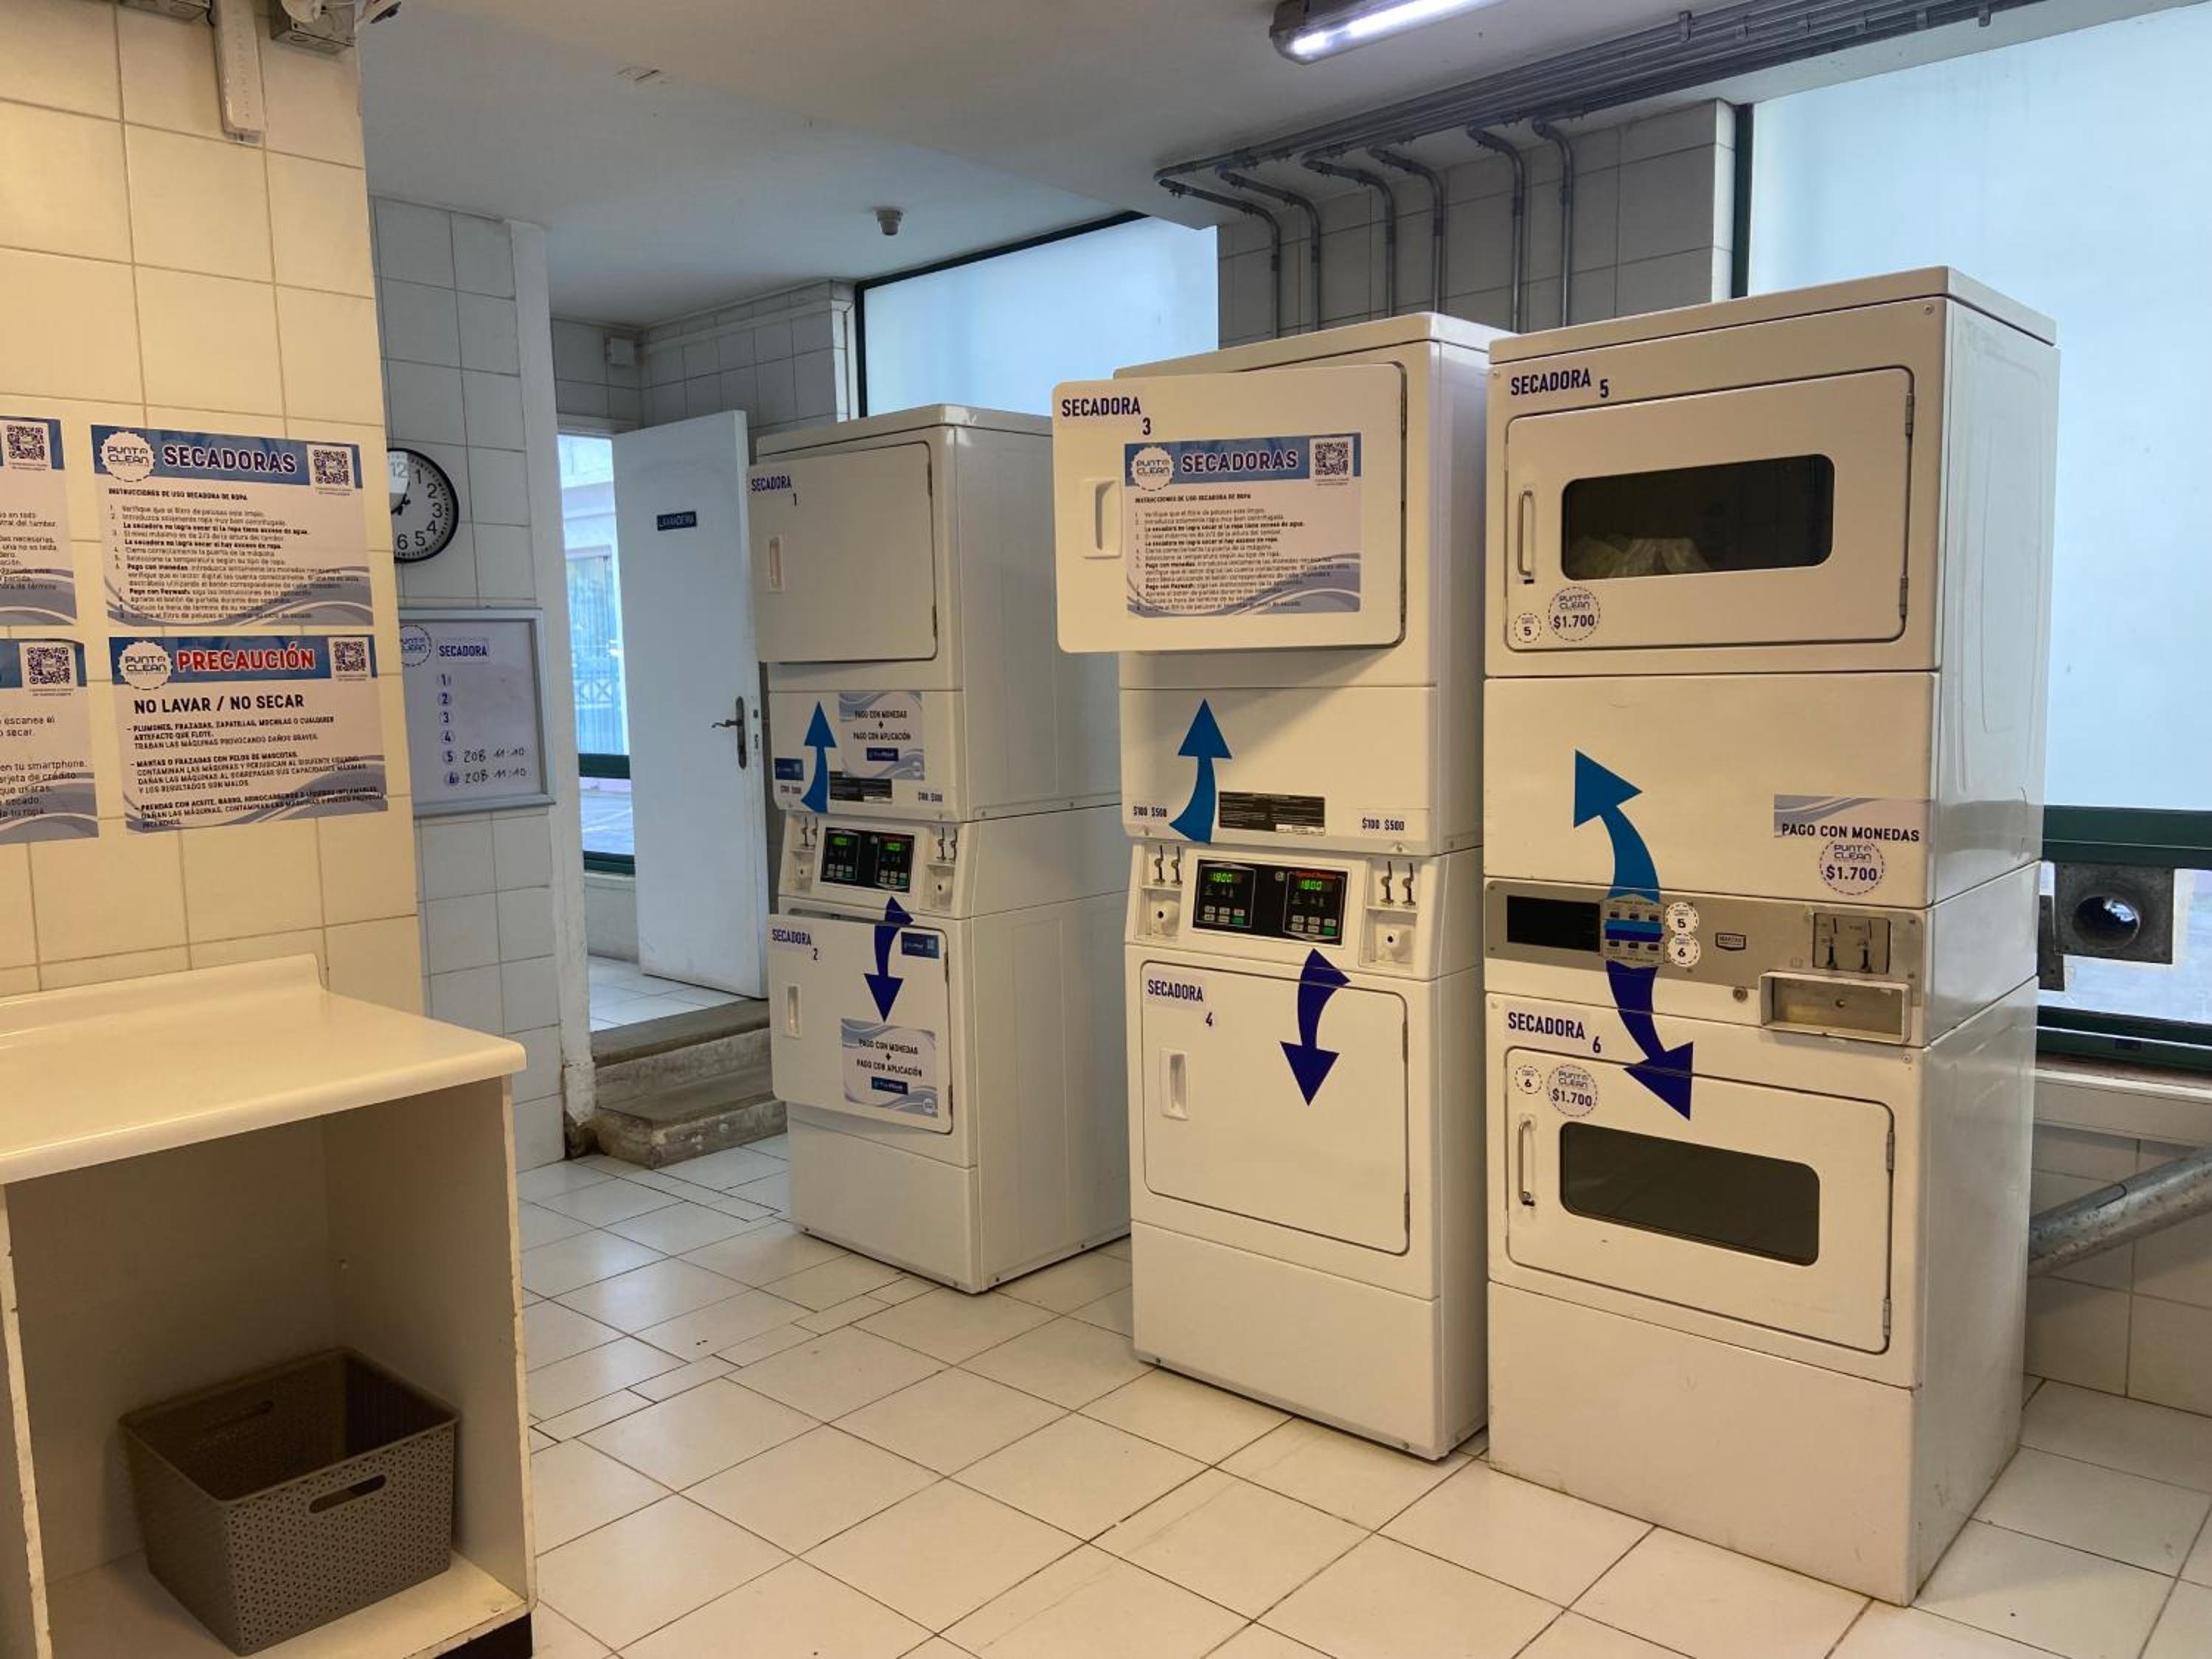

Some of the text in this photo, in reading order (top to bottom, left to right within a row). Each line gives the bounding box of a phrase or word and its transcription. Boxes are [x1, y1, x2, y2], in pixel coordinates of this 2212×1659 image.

[1511, 368, 1610, 398] SECADORA 5
[1061, 397, 1141, 417] SECADORA
[1142, 417, 1152, 435] 3
[164, 446, 295, 473] SECADORAS
[1183, 451, 1298, 473] SECADORAS
[390, 462, 407, 479] 12
[415, 469, 421, 484] 1
[427, 483, 437, 499] 2
[752, 476, 792, 491] SECADORA
[109, 488, 159, 496] INSTRUCCIONES
[793, 493, 797, 507] 1
[432, 503, 443, 518] 3
[426, 520, 438, 535] 4
[397, 534, 408, 550] 6
[415, 531, 425, 546] 5
[1554, 615, 1595, 629] $1.700
[1524, 627, 1531, 636] 5
[177, 642, 315, 671] PRECAUCIÓN
[439, 646, 487, 657] SECADORA
[441, 674, 446, 686] 1
[135, 694, 304, 714] NO LAVAR / NO SECAR
[442, 693, 448, 705] 2
[444, 712, 449, 723] 3
[882, 710, 907, 719] MONEDAS
[445, 731, 451, 742] 4
[448, 751, 453, 762] 5
[28, 759, 87, 771] smartphone.
[449, 773, 455, 784] 6
[1362, 819, 1404, 832] $100 $500
[1782, 824, 1920, 842] PAGO CON MONEDAS
[1826, 864, 1877, 881] $1.700
[1677, 919, 1686, 928] 5
[773, 929, 811, 946] SECADORA
[814, 948, 818, 960] 2
[1677, 948, 1686, 957] 6
[1148, 979, 1204, 1002] SECADORA
[1206, 1012, 1213, 1027] 4
[1508, 1012, 1601, 1053] SECADORA 6
[889, 1044, 918, 1054] MONEDAS
[1524, 1079, 1532, 1088] 6
[1552, 1088, 1592, 1106] $1.700
